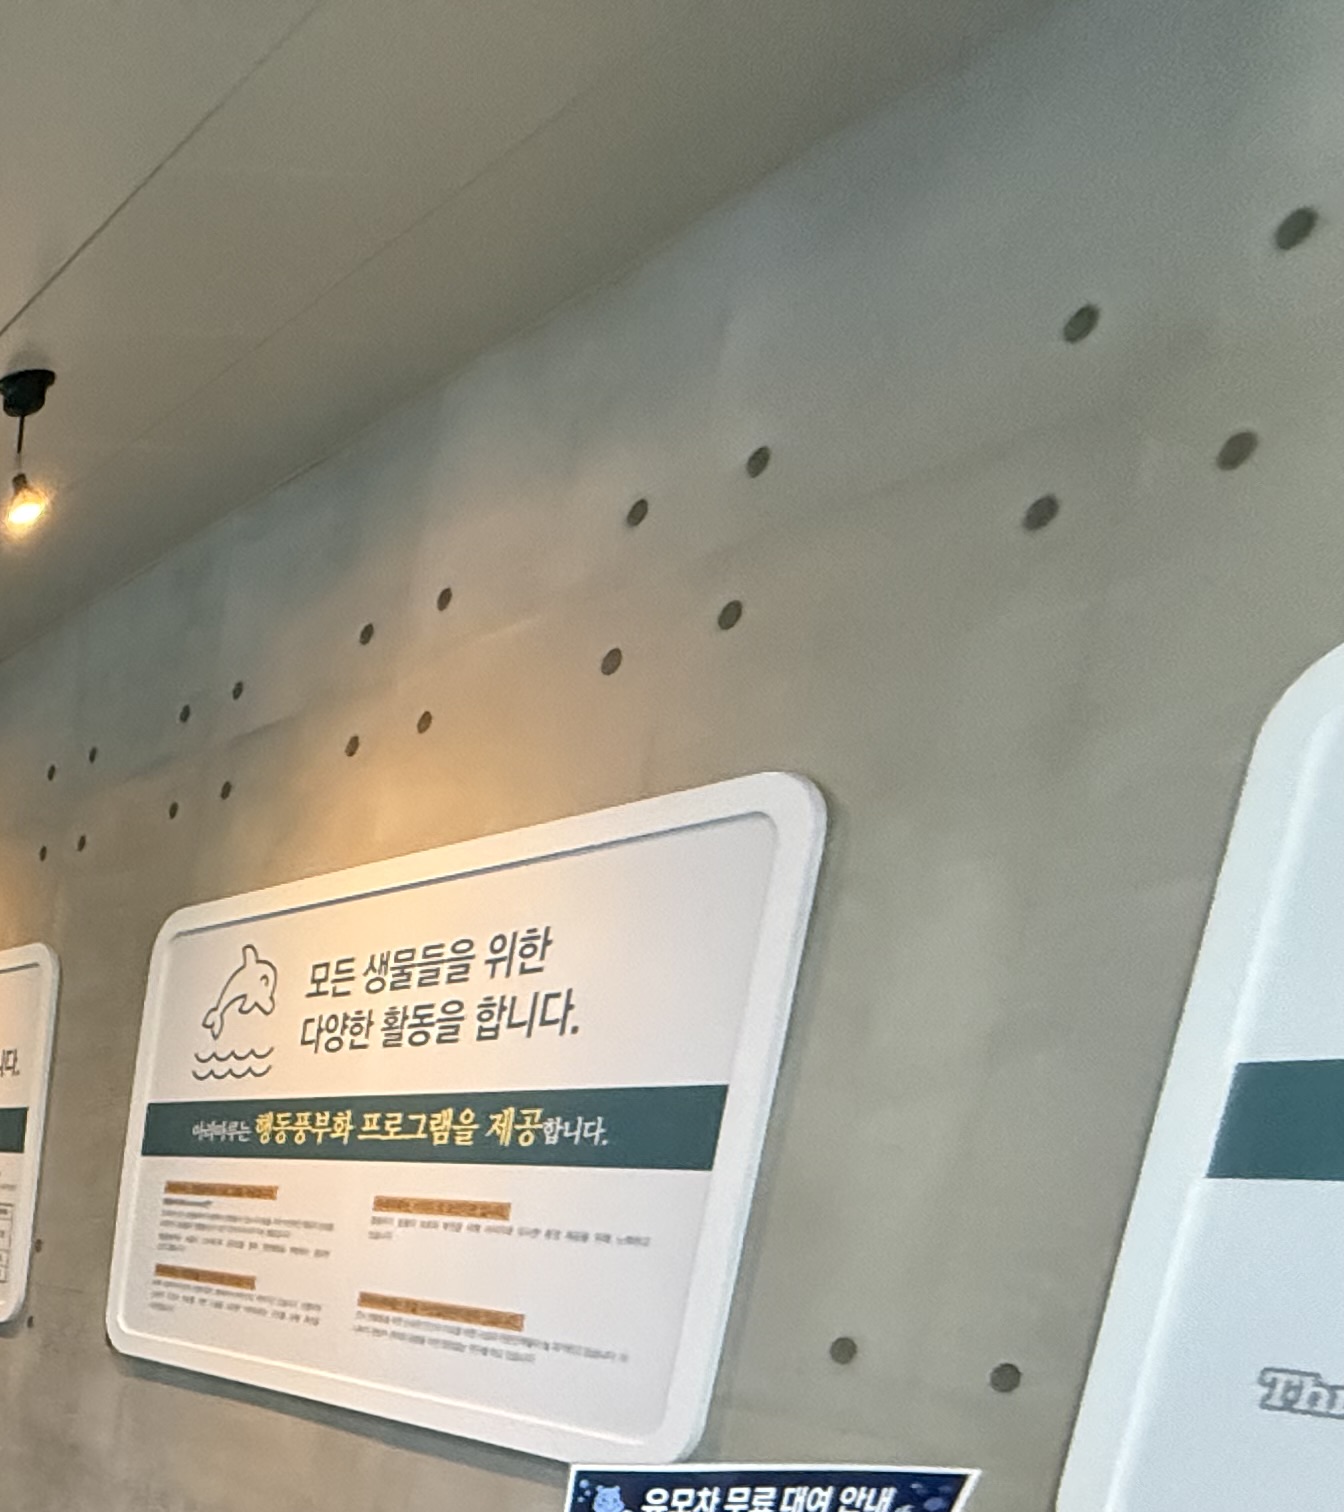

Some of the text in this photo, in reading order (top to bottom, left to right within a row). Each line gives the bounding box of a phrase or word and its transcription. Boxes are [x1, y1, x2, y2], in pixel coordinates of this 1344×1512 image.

[305, 926, 553, 998] 모든 생물들을 위한
[300, 988, 579, 1054] 다양한 활동을 합니다.
[254, 1111, 354, 1145] 행동풍부화
[357, 1108, 479, 1146] 프로그램을
[484, 1106, 609, 1147] 제공합니다.
[1258, 1367, 1344, 1419] Th
